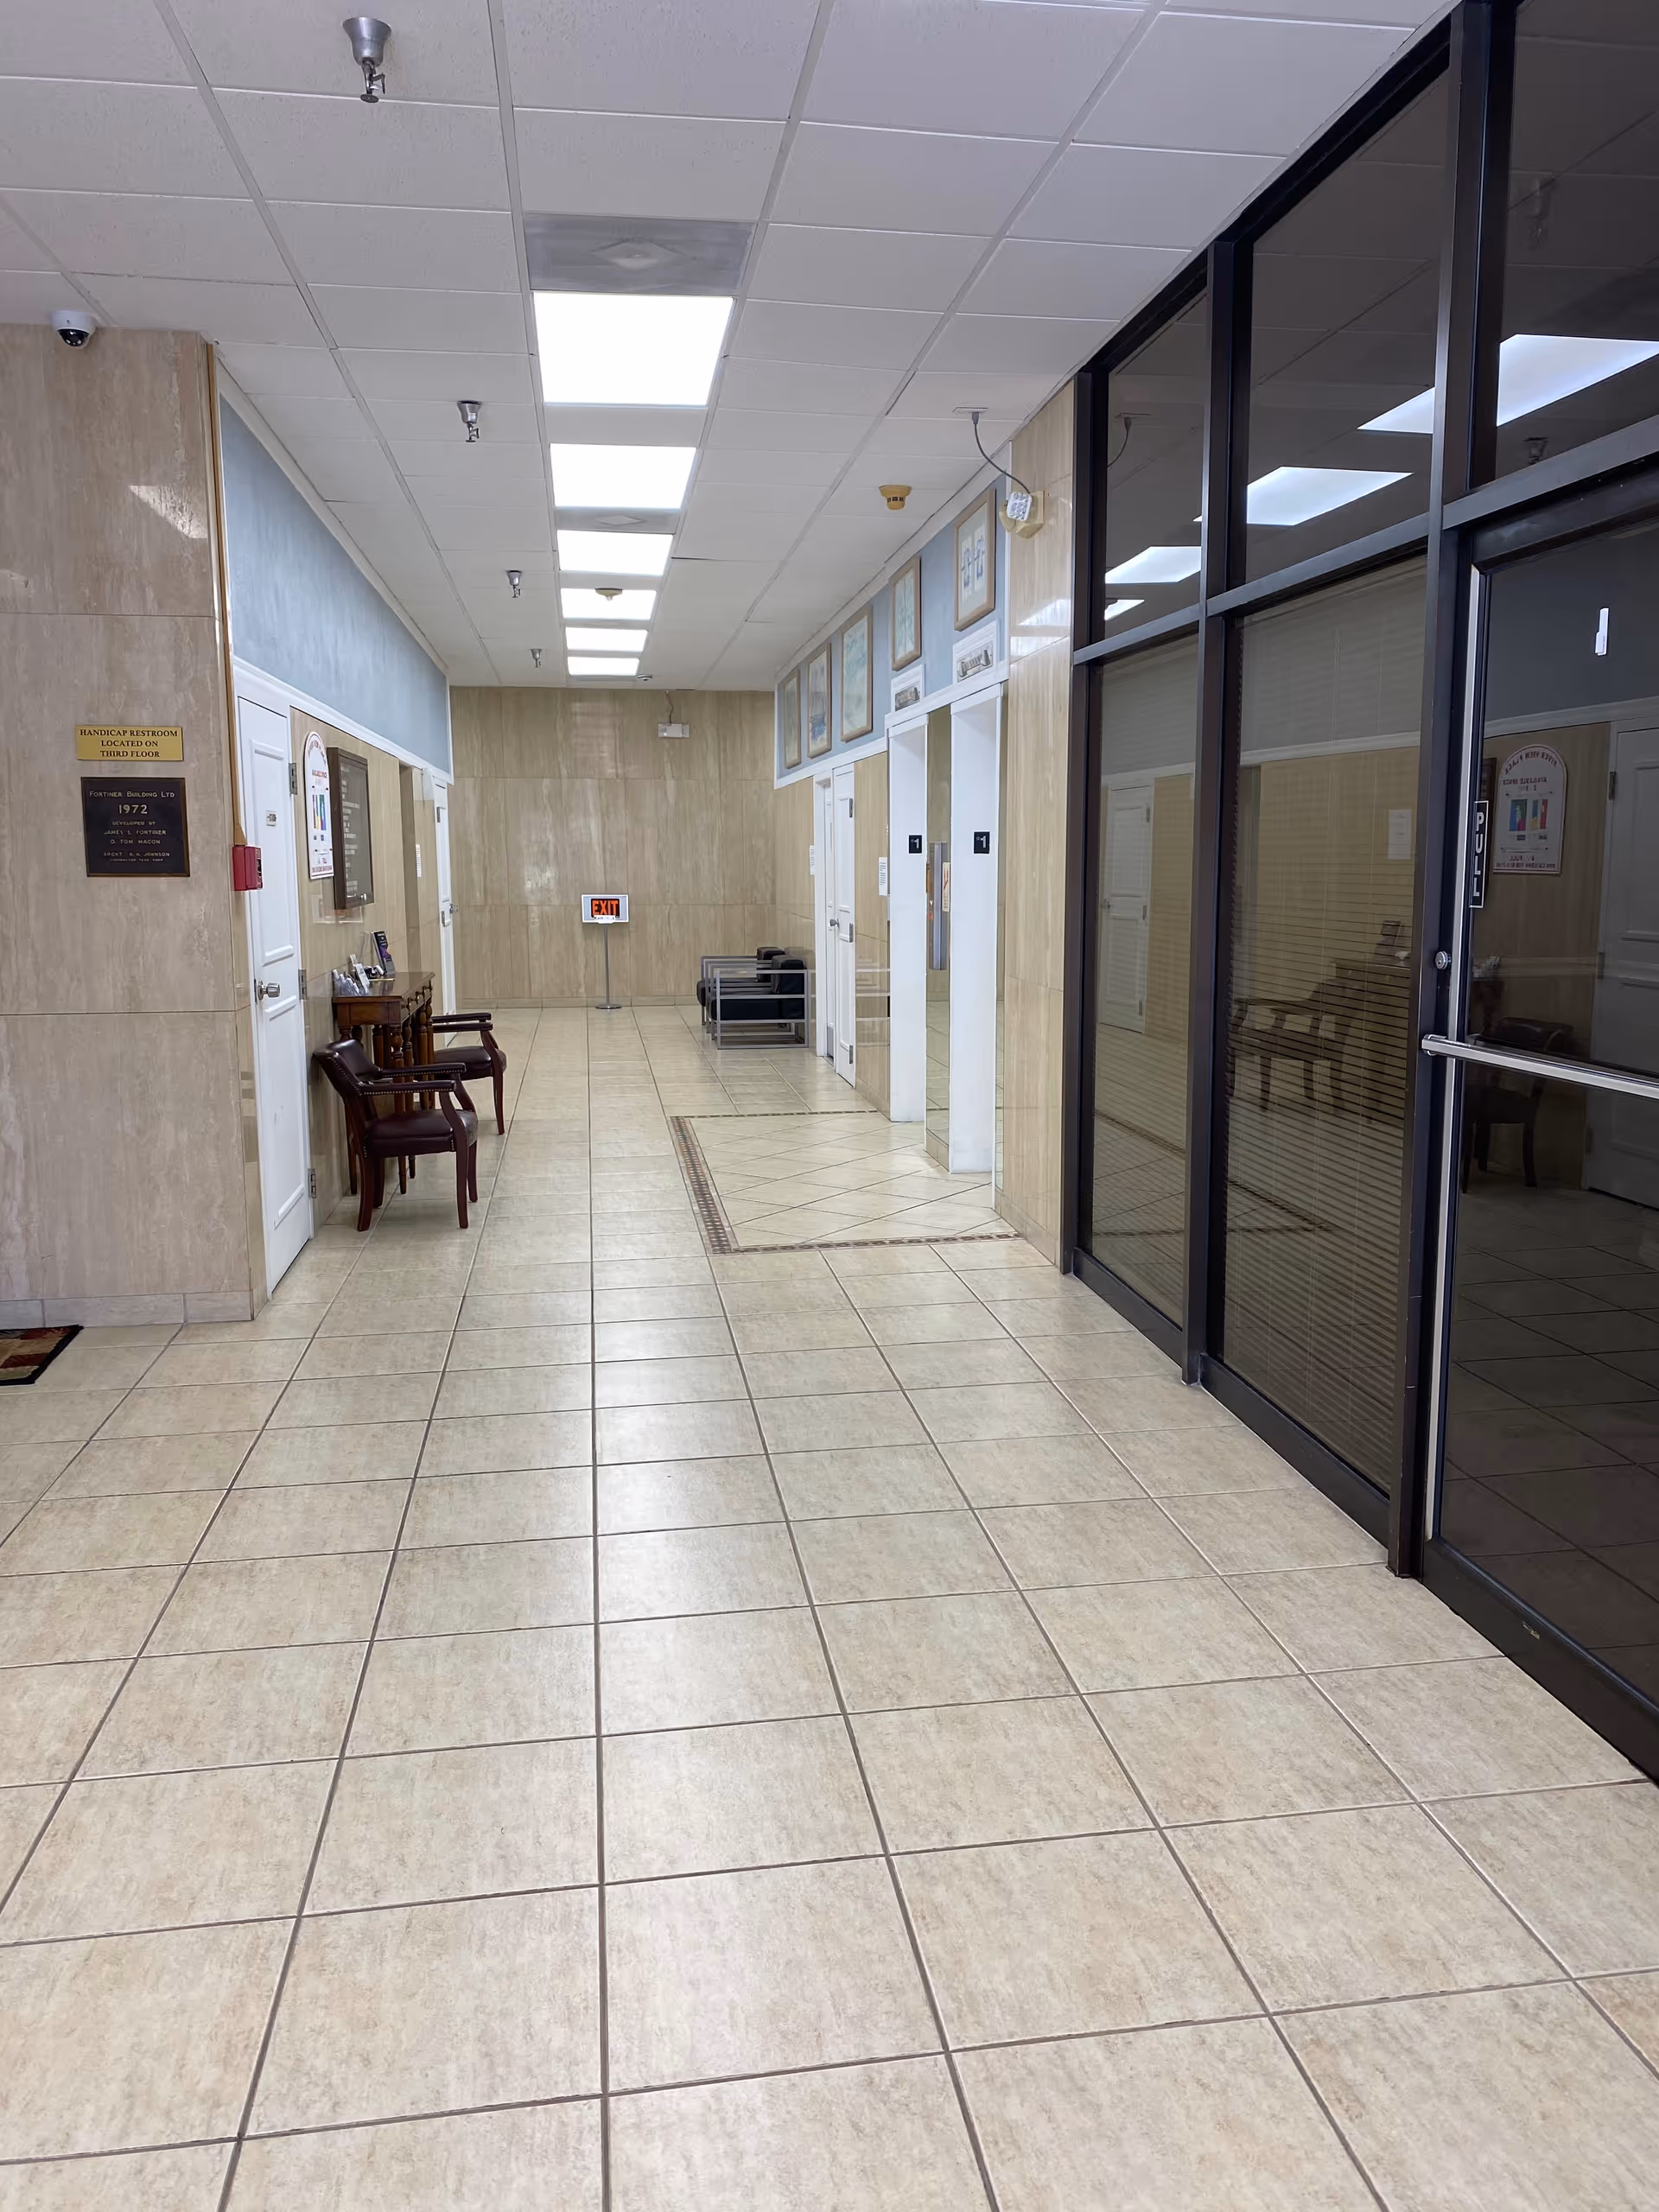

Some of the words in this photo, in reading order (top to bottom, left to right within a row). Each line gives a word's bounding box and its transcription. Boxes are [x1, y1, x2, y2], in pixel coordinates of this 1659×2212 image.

[118, 804, 148, 815] 1972
[980, 836, 986, 848] 1
[1473, 811, 1484, 897] PULL
[592, 899, 619, 915] EXIT
